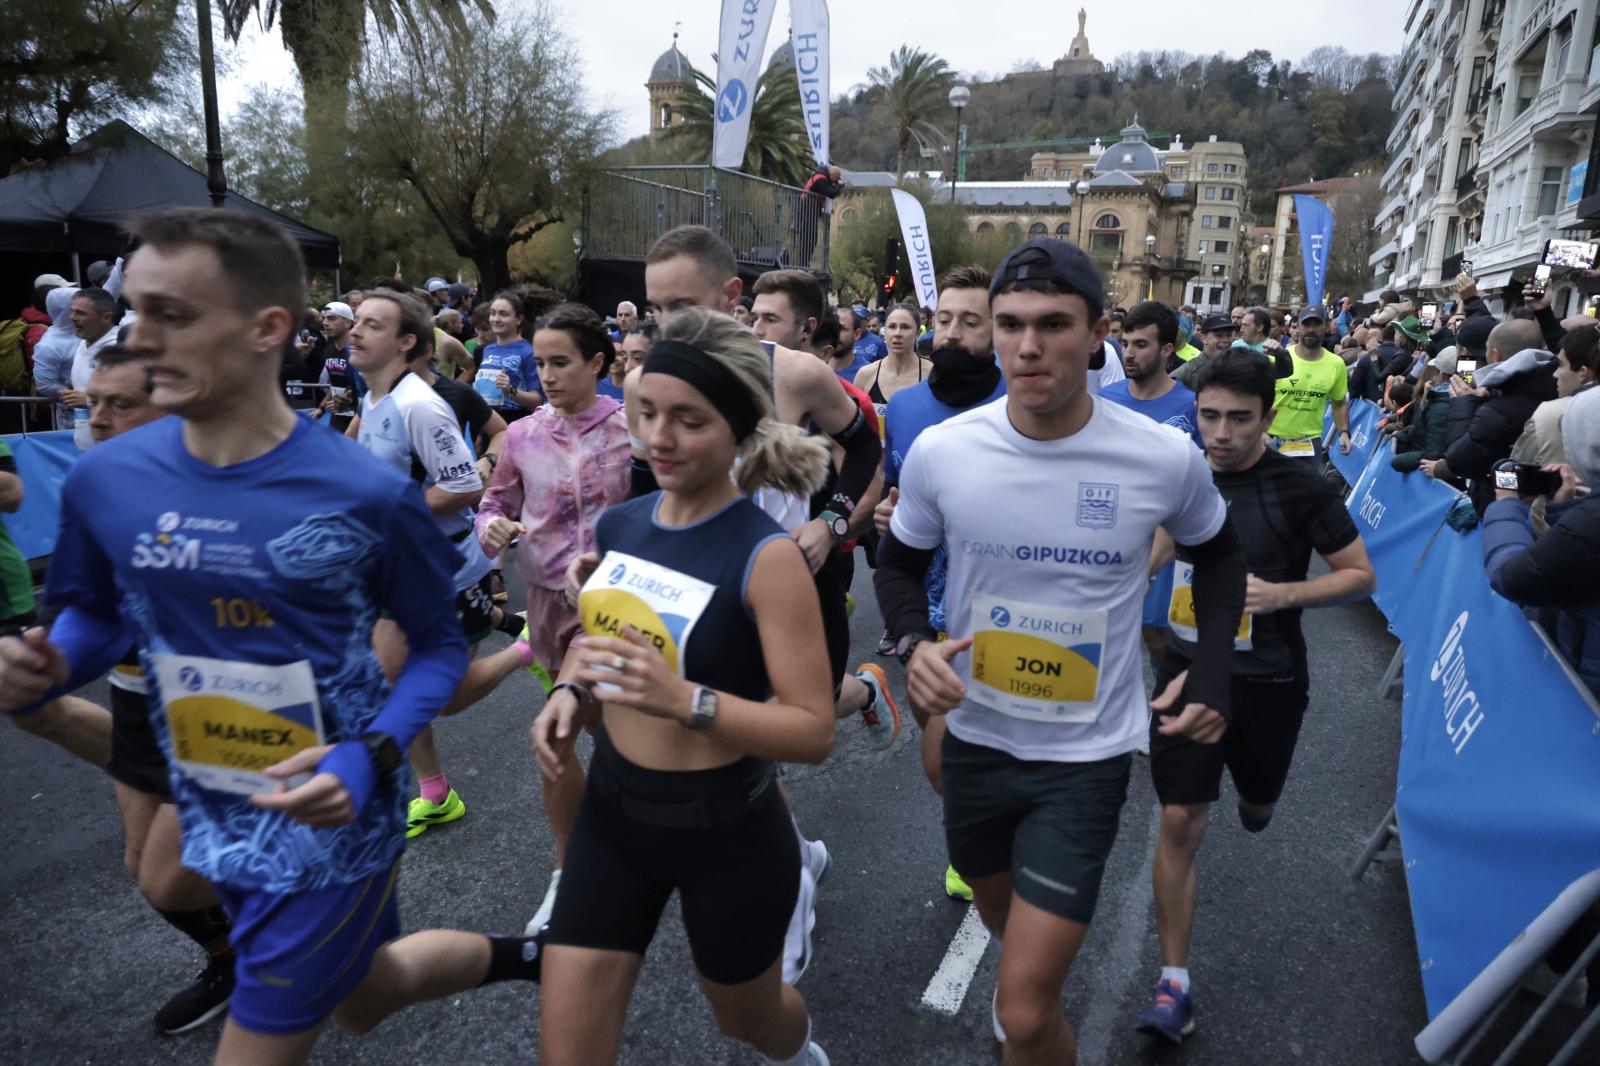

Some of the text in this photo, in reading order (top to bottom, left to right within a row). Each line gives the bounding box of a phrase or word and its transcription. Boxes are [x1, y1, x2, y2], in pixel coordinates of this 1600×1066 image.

[1085, 488, 1111, 498] GIF
[627, 572, 682, 602] ZURICH
[1018, 616, 1083, 635] ZURICH
[1015, 656, 1062, 677] JON
[211, 674, 283, 697] ZURICH
[1008, 678, 1053, 698] 11996
[1443, 645, 1484, 754] ZURICH
[203, 719, 295, 747] MANEX
